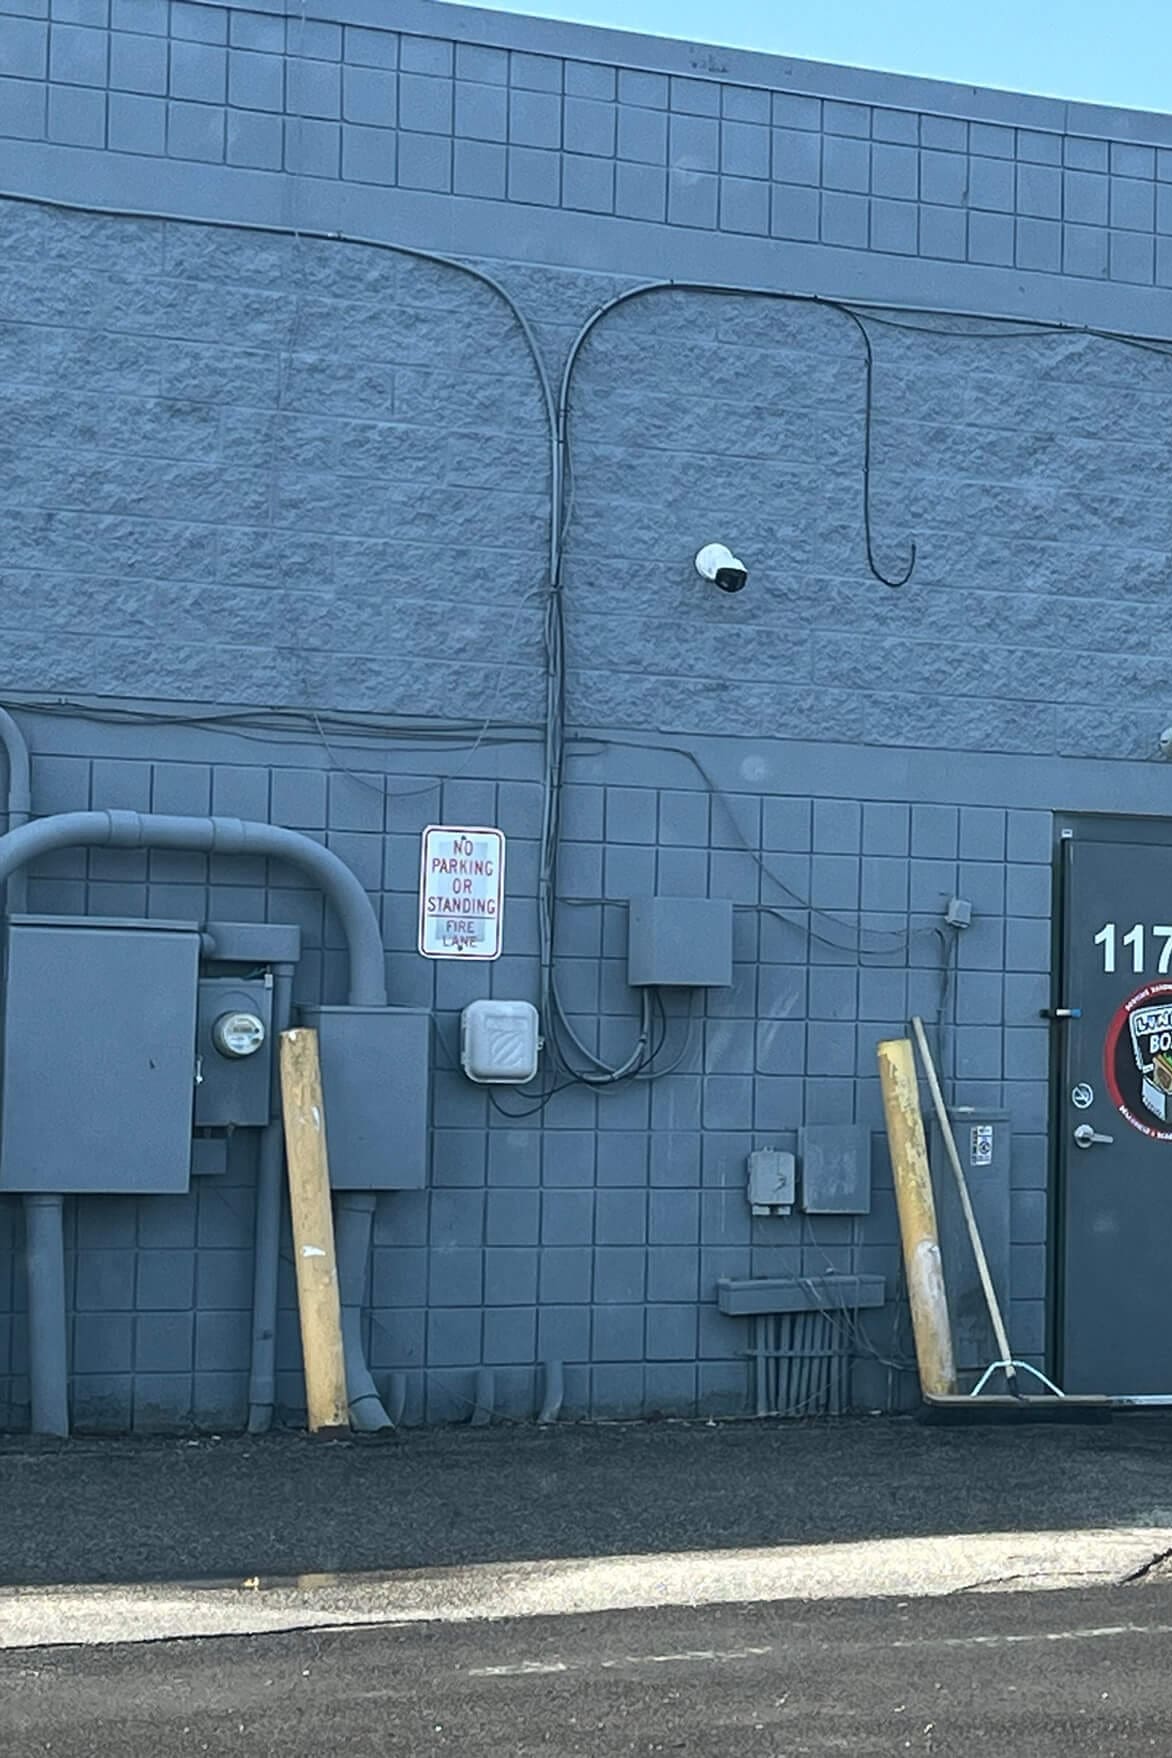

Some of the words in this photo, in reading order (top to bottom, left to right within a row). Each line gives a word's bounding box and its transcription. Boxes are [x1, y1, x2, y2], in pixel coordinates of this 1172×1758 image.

[453, 840, 473, 856] NO
[432, 858, 493, 876] PARKING
[453, 878, 472, 894] OR
[428, 896, 495, 914] STANDING
[446, 920, 474, 933] FIRE
[442, 936, 477, 948] LANE
